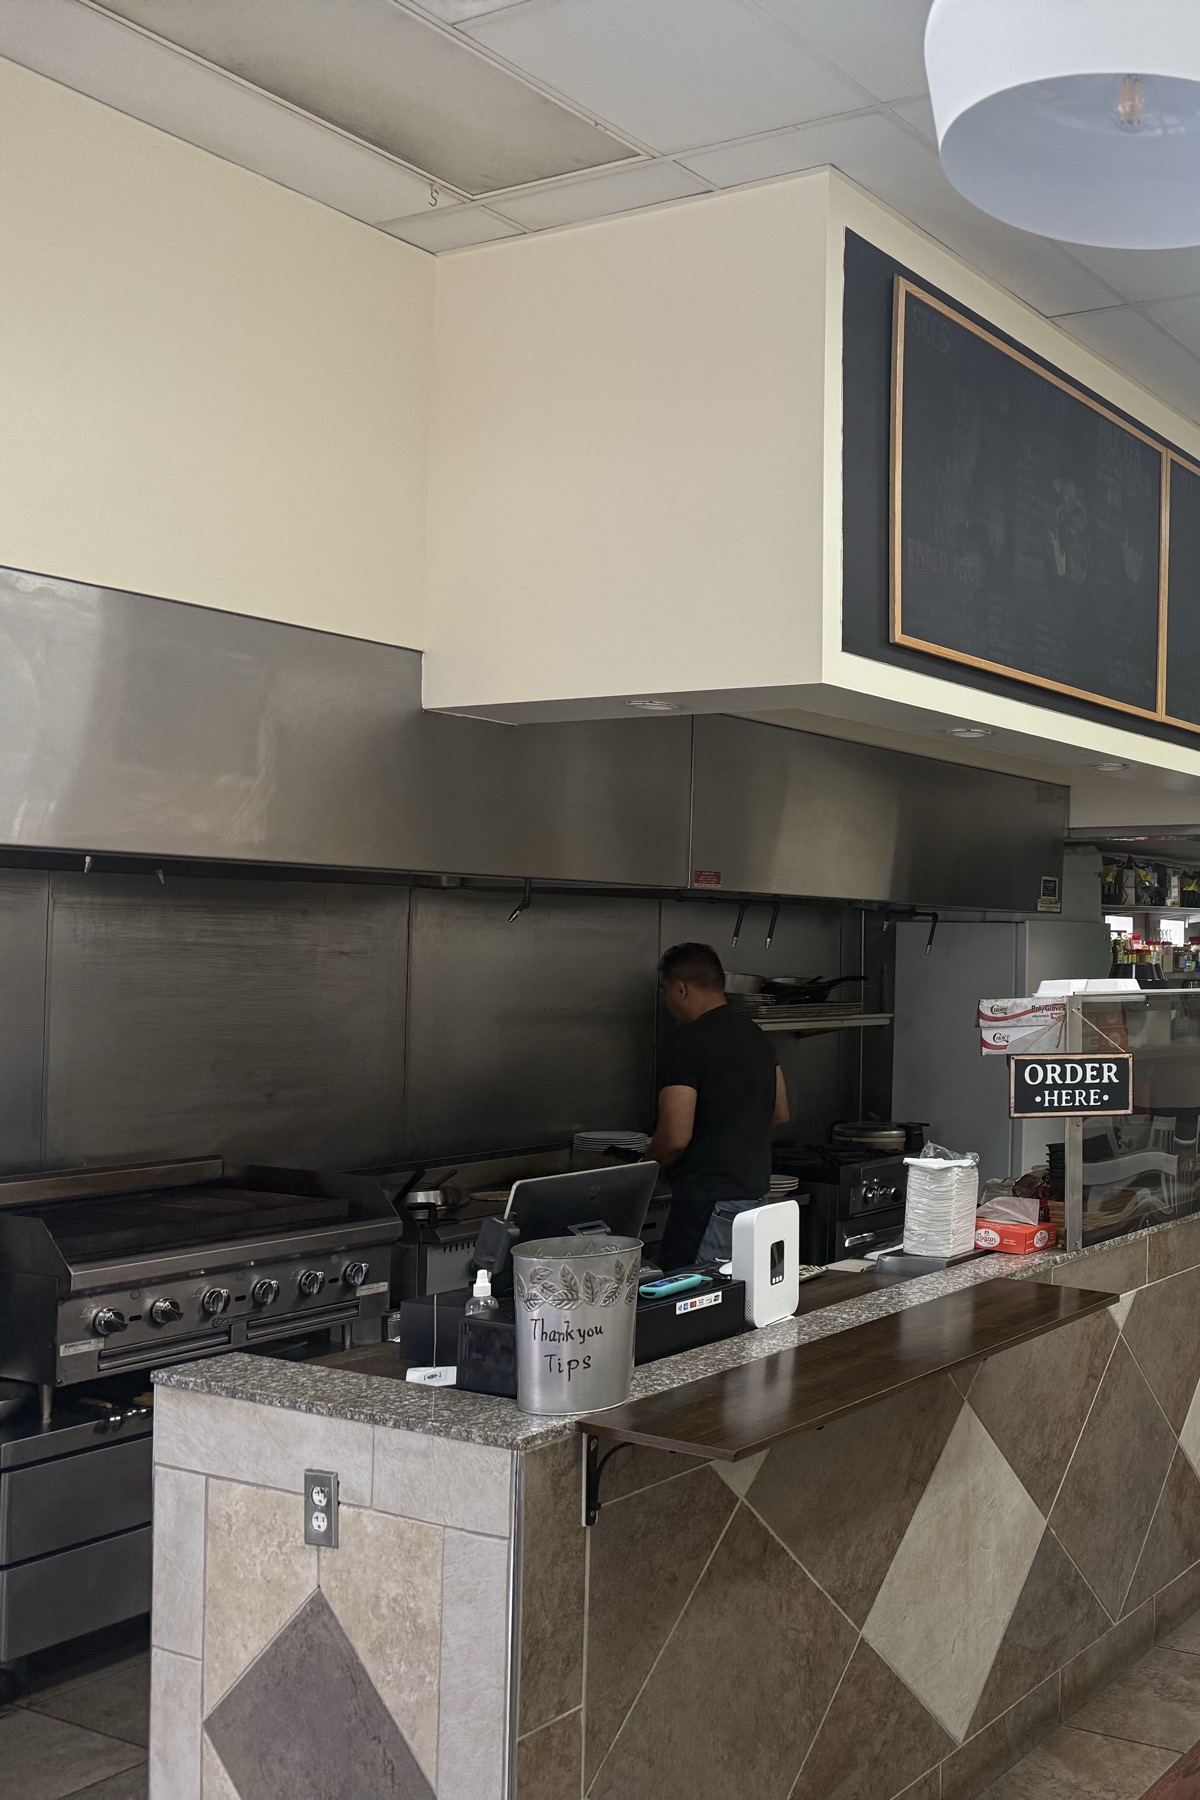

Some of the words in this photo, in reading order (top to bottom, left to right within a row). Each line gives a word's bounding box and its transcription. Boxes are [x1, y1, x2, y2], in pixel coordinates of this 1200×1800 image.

[911, 305, 950, 354] SIDES
[1031, 1004, 1044, 1014] Poly
[1044, 1004, 1066, 1012] Gloves
[1024, 1063, 1120, 1085] ORDER
[1043, 1088, 1102, 1108] HERE
[977, 1233, 997, 1243] Logan
[530, 1317, 575, 1344] Thank
[576, 1325, 604, 1345] you
[543, 1354, 592, 1382] Tips
